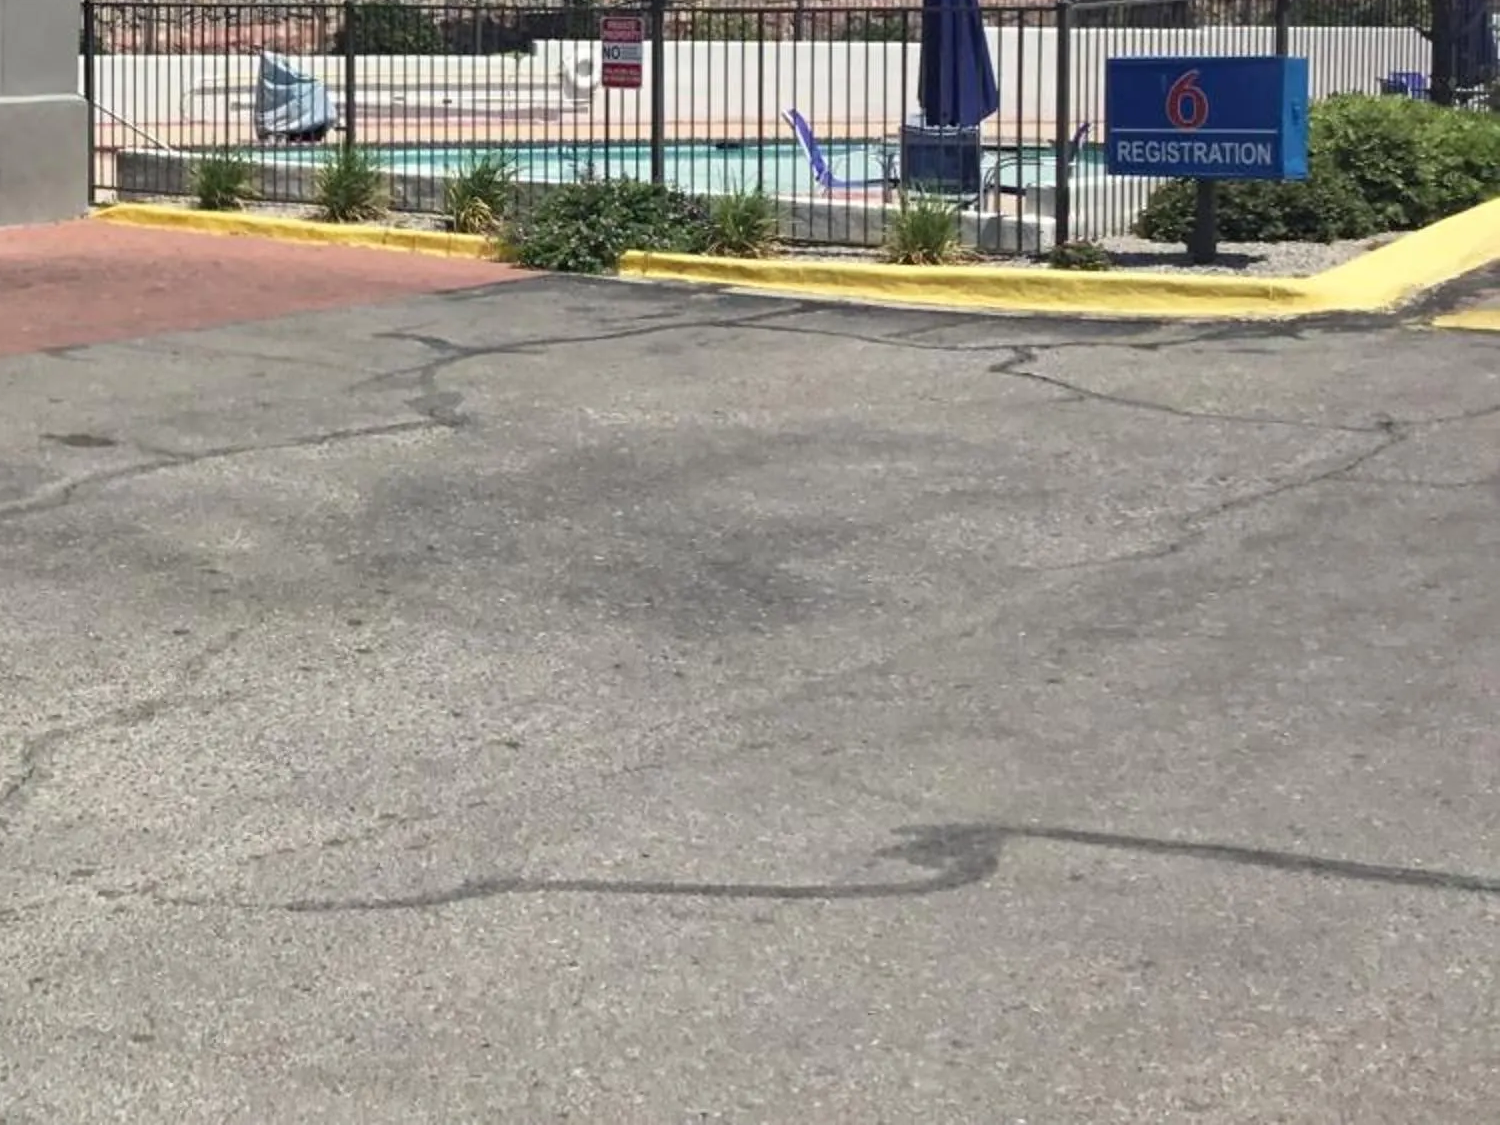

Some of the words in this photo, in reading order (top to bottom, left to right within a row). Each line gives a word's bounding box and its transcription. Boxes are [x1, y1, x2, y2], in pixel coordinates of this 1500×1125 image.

[603, 45, 621, 59] NO
[1165, 69, 1209, 133] 6
[1117, 140, 1272, 166] REGISTRATION
